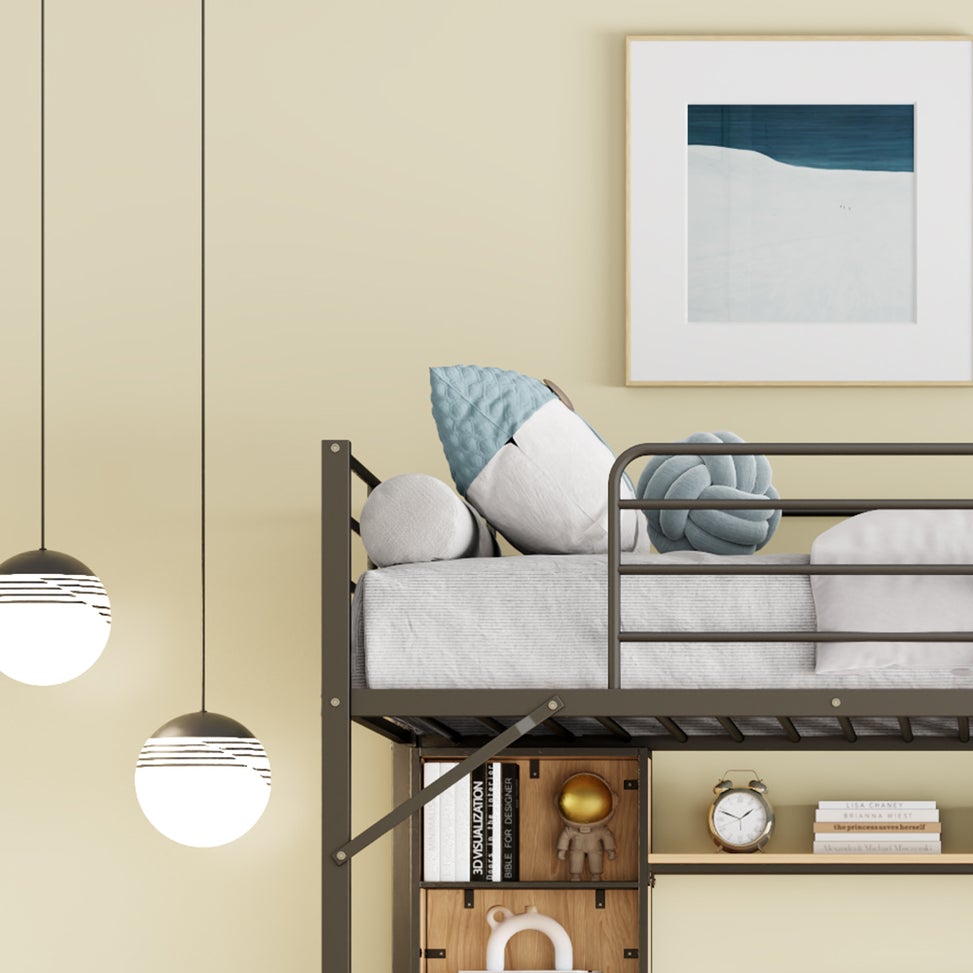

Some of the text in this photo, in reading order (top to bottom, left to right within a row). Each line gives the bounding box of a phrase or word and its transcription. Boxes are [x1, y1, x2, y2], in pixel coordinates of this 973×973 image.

[473, 781, 483, 875] 3D VISUALIZATION
[504, 778, 512, 878] BIBLE FOR DESIGNER
[846, 824, 878, 832] princess
